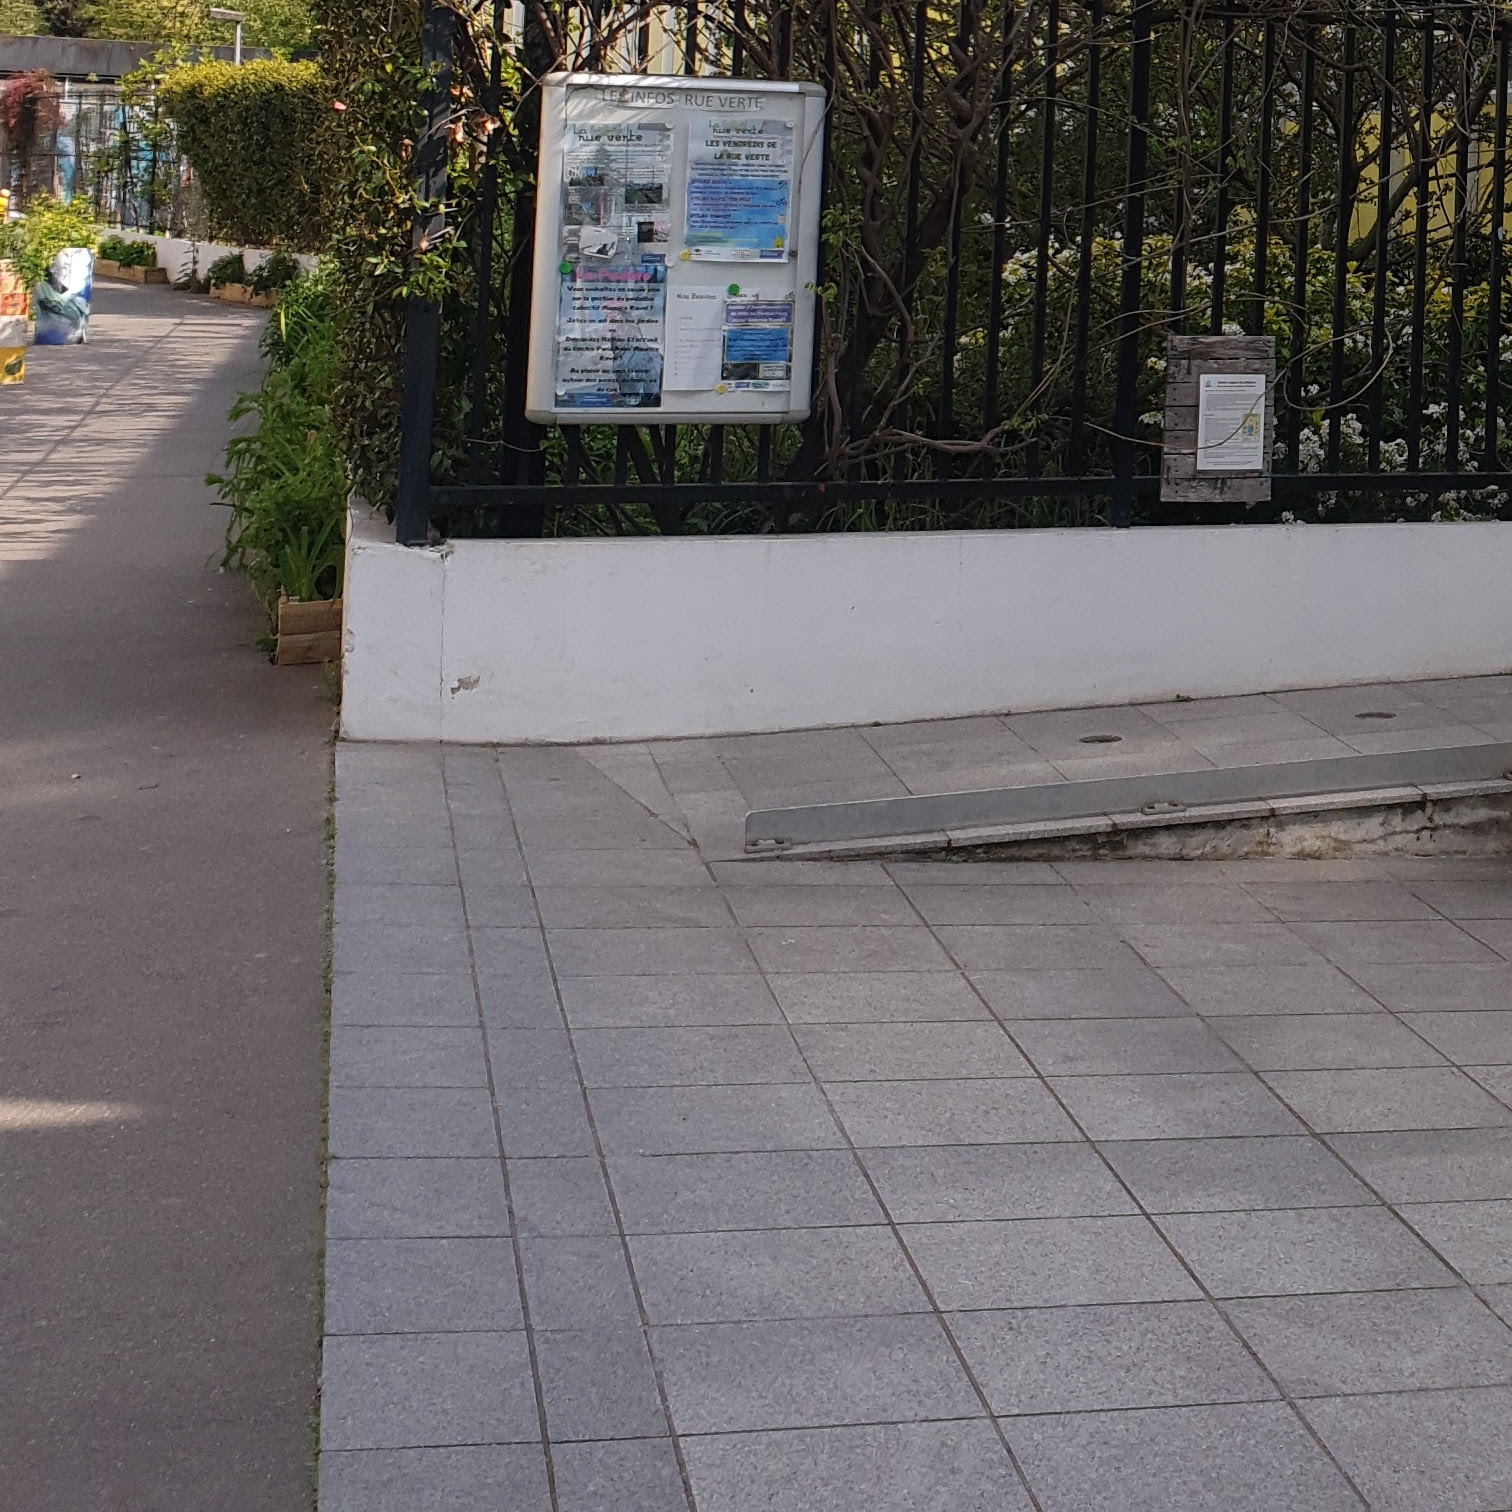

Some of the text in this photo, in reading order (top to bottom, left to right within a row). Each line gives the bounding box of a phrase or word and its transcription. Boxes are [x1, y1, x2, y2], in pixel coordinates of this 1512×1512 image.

[631, 90, 675, 105] INFOS
[684, 93, 715, 108] RUE
[718, 95, 764, 110] VERTE
